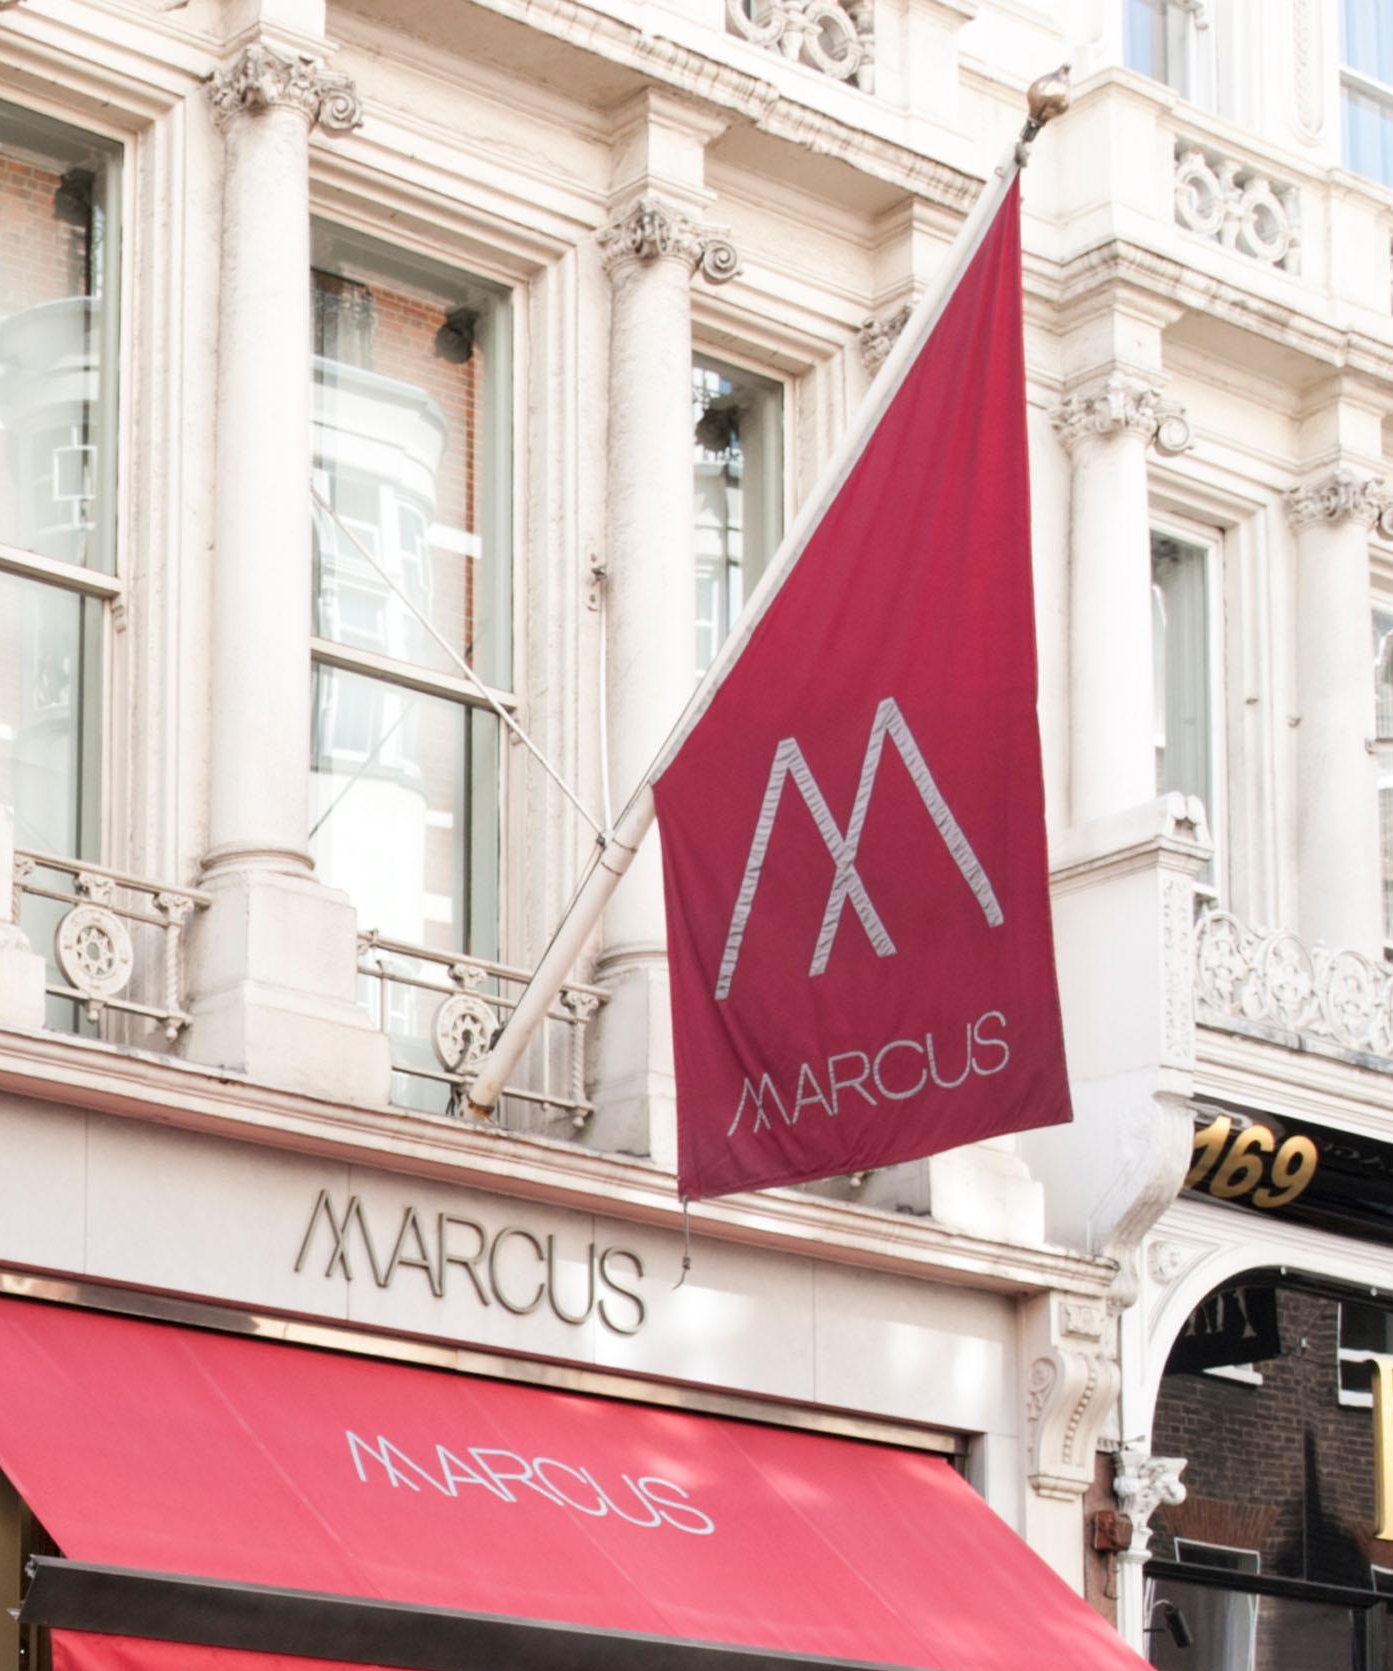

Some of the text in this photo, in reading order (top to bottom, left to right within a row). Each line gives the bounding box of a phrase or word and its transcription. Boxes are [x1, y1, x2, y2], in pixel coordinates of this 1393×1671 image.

[726, 1010, 1011, 1137] MARCUS
[1184, 1114, 1319, 1208] 169
[294, 1188, 647, 1337] MARCUS
[344, 1429, 716, 1536] MARCUS
